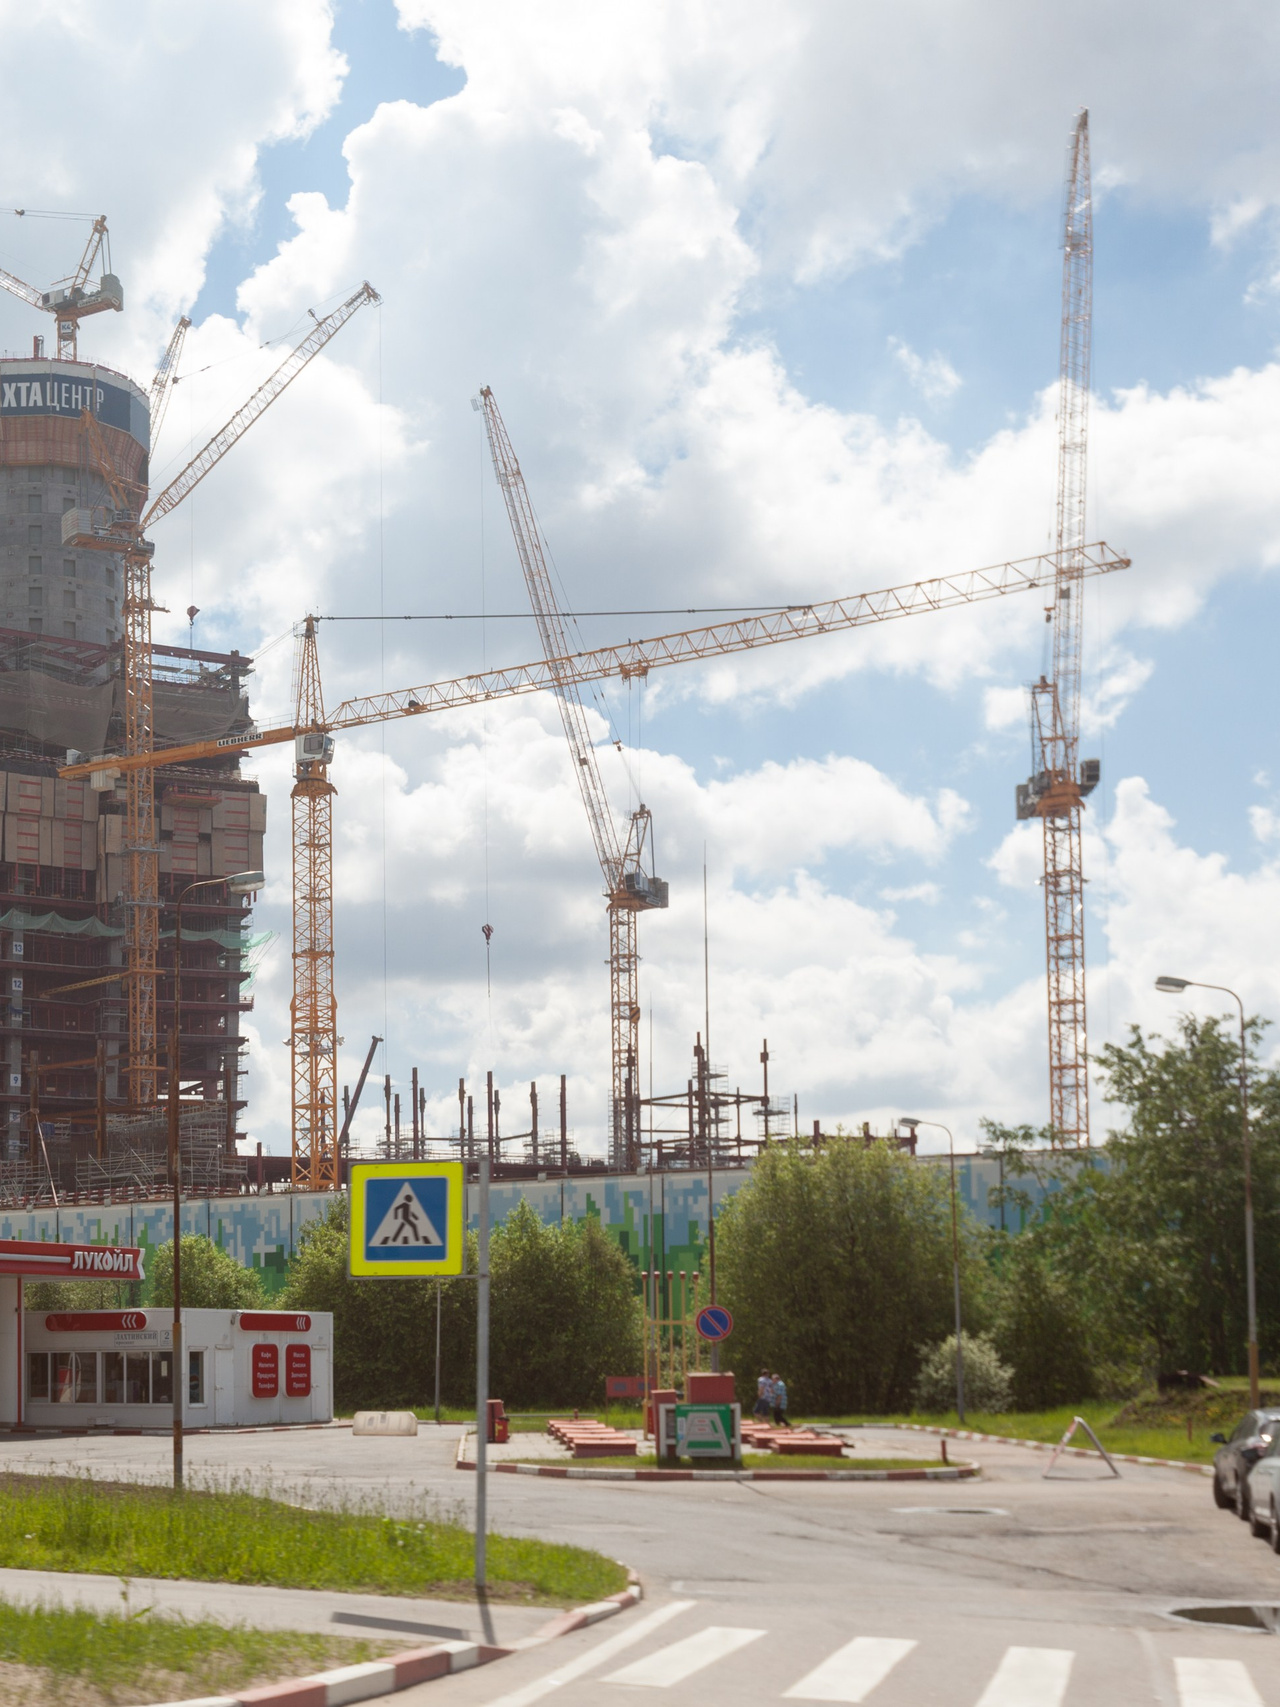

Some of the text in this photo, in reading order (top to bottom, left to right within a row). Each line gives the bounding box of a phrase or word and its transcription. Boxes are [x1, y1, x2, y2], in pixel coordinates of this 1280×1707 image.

[46, 382, 104, 412] ЦЕНТР
[218, 733, 262, 747] LIEBHERR
[14, 943, 22, 953] 13
[13, 979, 22, 989] 12
[13, 1076, 19, 1085] 9
[72, 1248, 134, 1272] ЛУКОЙЛ
[116, 1331, 170, 1341] ЛАХТИНСКИЙ 2
